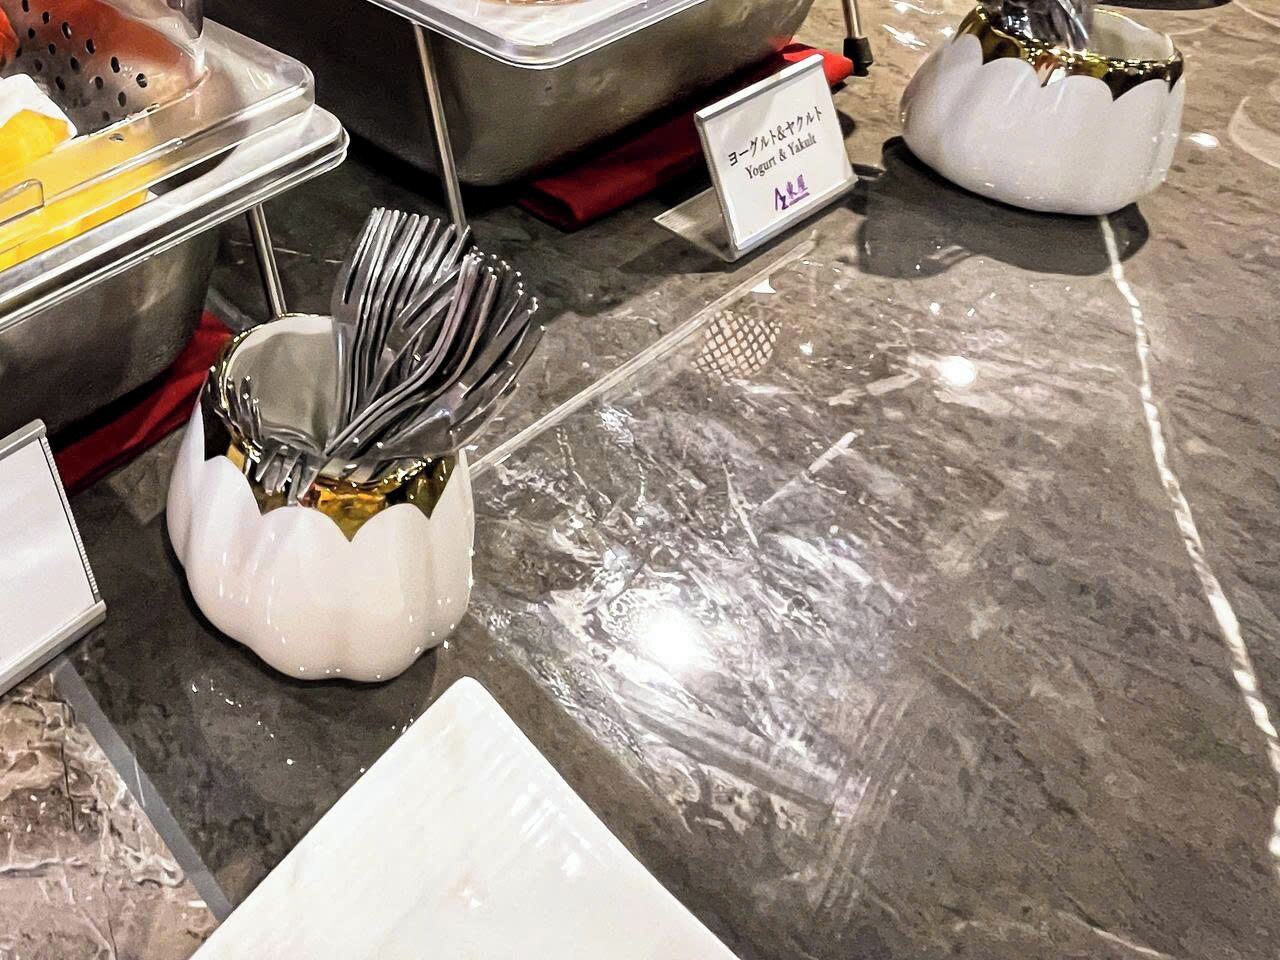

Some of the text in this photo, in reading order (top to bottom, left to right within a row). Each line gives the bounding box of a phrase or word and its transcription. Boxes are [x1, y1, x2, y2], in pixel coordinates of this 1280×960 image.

[745, 133, 817, 180] Yogurt & Yakult
